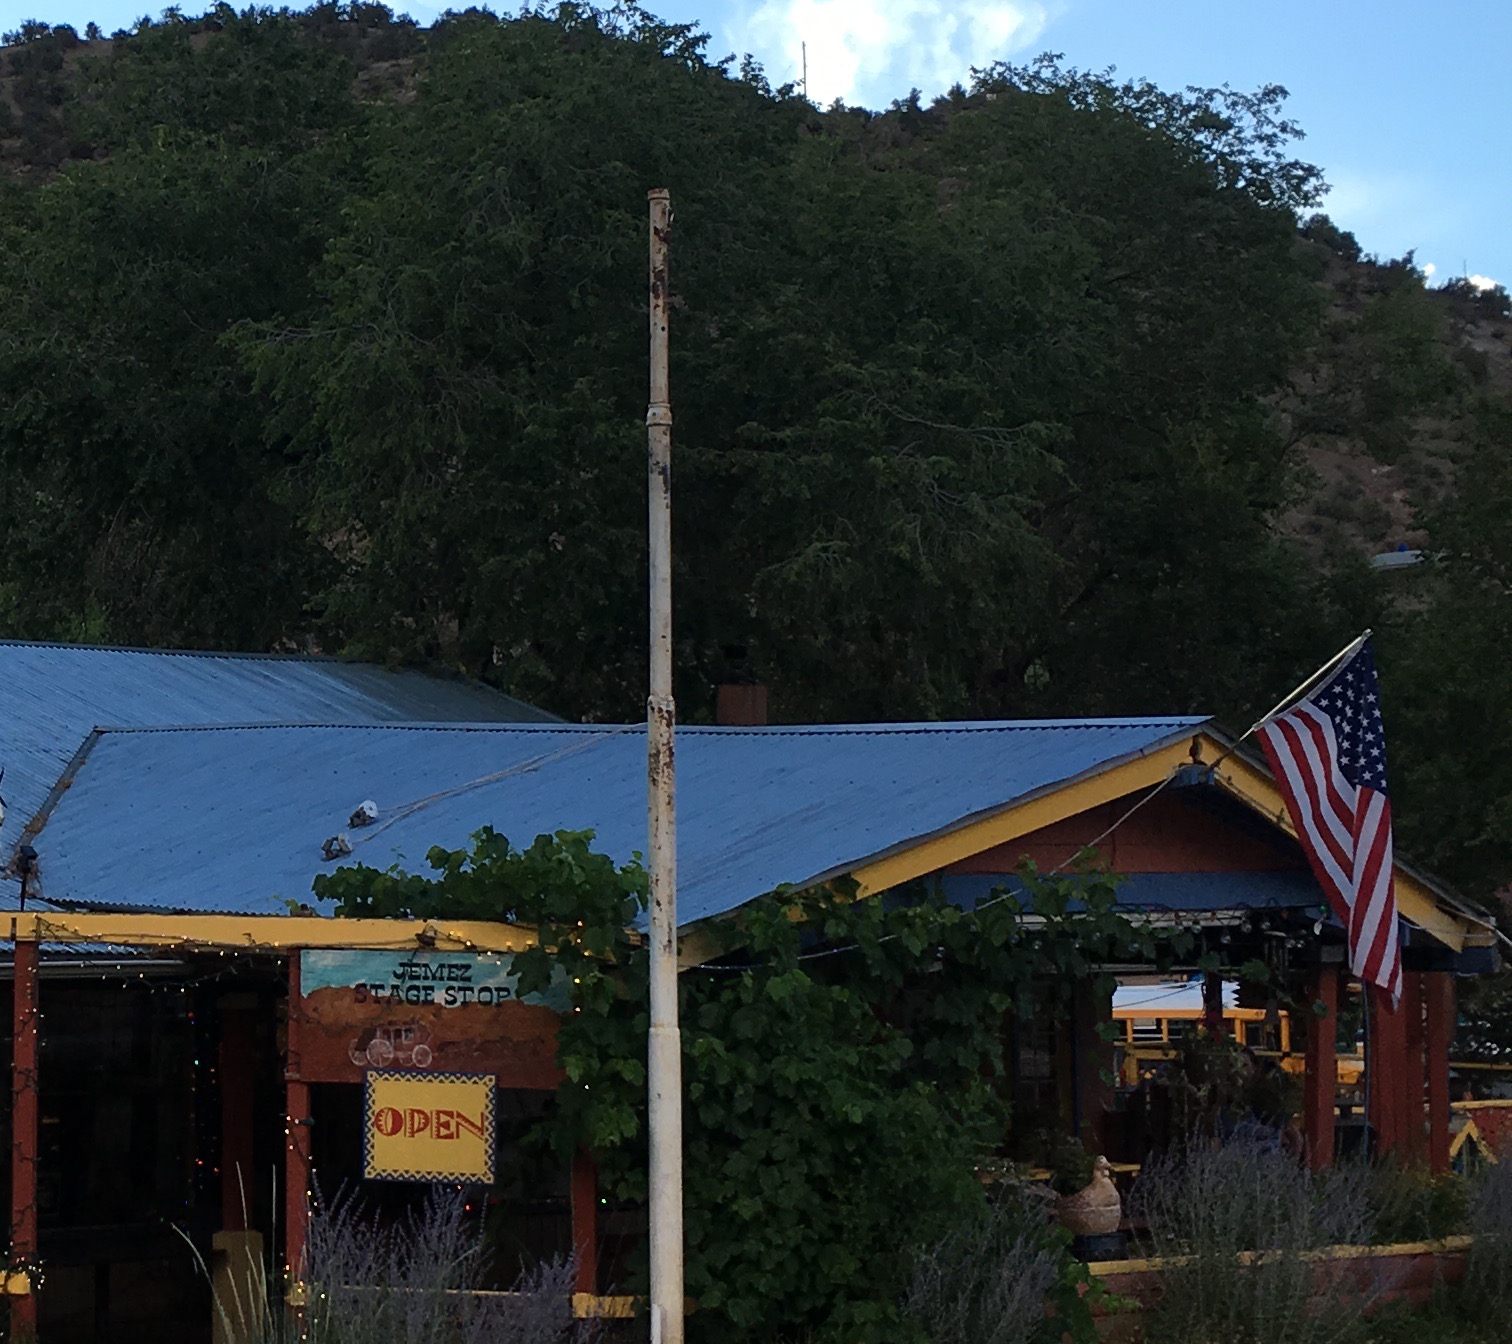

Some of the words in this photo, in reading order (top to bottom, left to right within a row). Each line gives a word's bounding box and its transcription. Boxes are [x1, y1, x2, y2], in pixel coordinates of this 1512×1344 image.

[392, 962, 473, 983] JEMEZ
[354, 983, 435, 1006] STAGE
[444, 985, 511, 1007] STOP
[374, 1107, 487, 1140] OPEN
